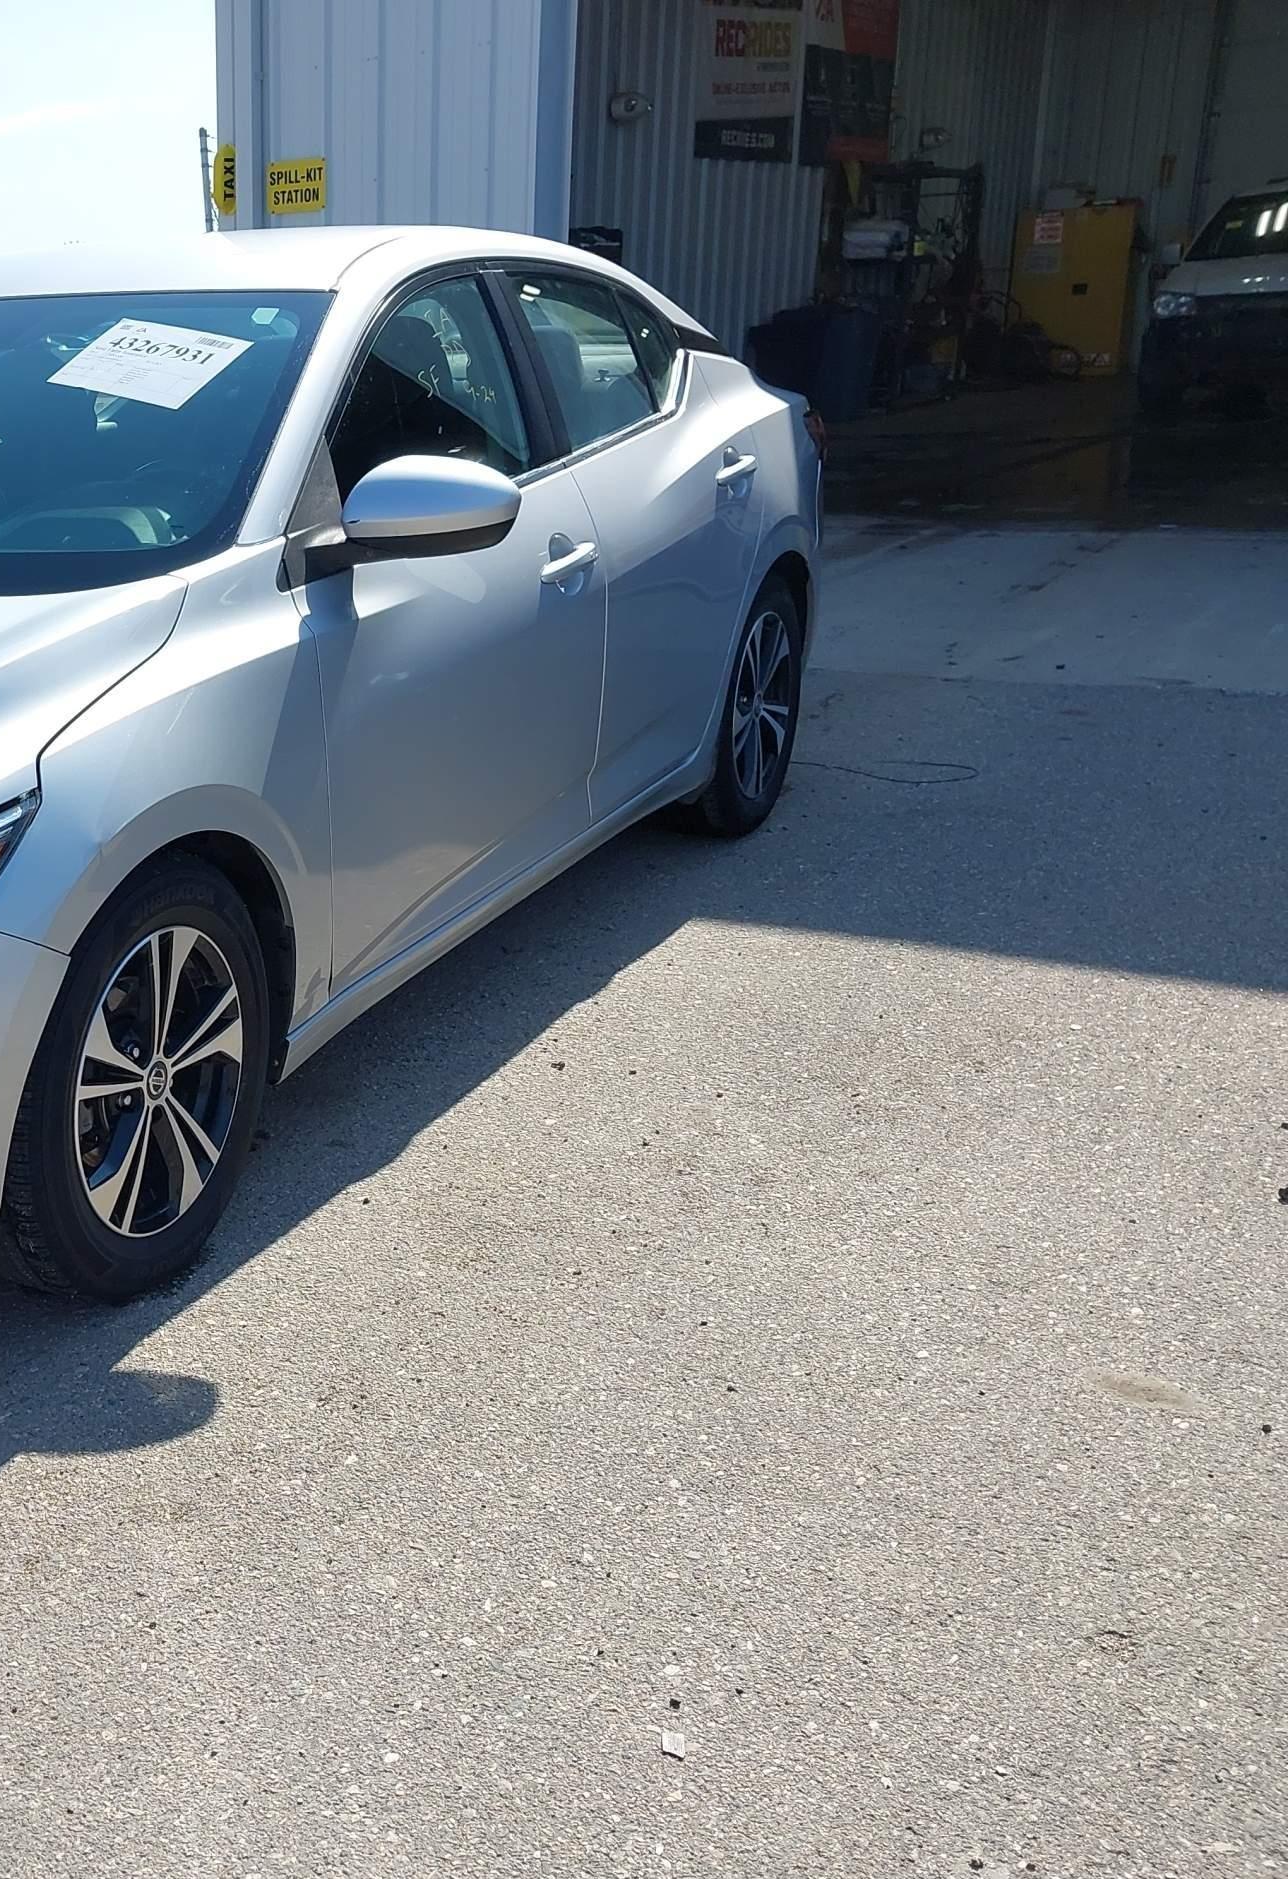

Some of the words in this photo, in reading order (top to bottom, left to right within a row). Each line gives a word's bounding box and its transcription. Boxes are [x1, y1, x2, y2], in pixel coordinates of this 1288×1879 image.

[223, 157, 235, 201] TAXI
[269, 167, 323, 186] SPILL-KIT
[273, 187, 320, 205] STATION
[109, 336, 215, 365] 43267931
